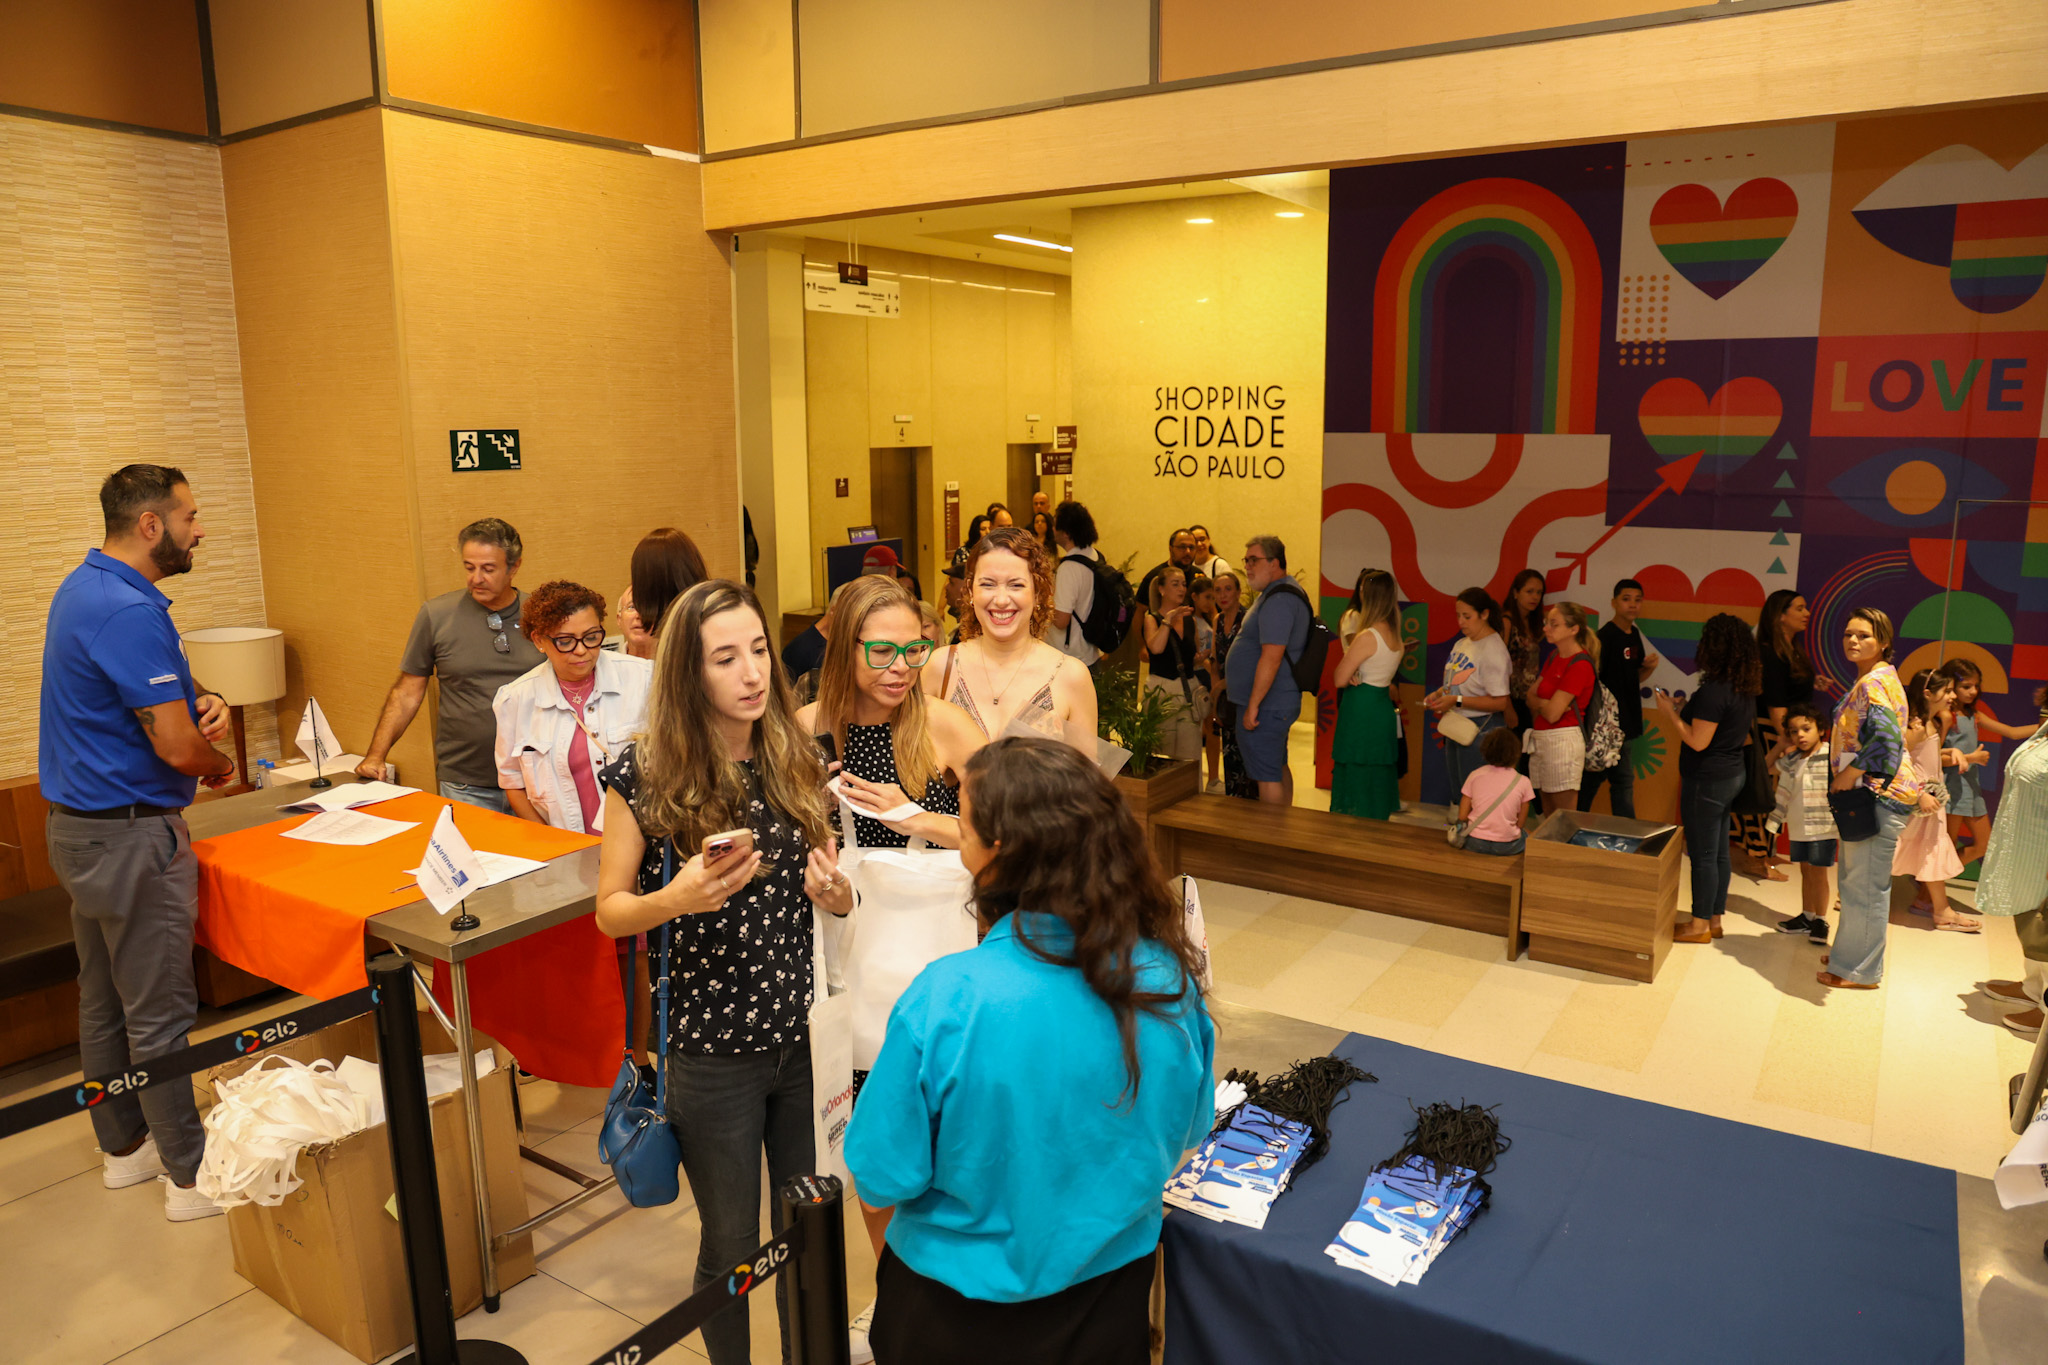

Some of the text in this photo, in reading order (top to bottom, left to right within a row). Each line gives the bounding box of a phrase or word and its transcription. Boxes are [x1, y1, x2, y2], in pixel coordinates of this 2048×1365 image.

[1155, 385, 1286, 411] SHOPPING
[1831, 358, 2027, 412] LOVE
[1155, 415, 1284, 448] CIDADE
[1155, 450, 1285, 479] SÃO PAULO
[262, 1020, 297, 1043] elo
[107, 1070, 149, 1095] elo
[754, 1242, 789, 1277] elo
